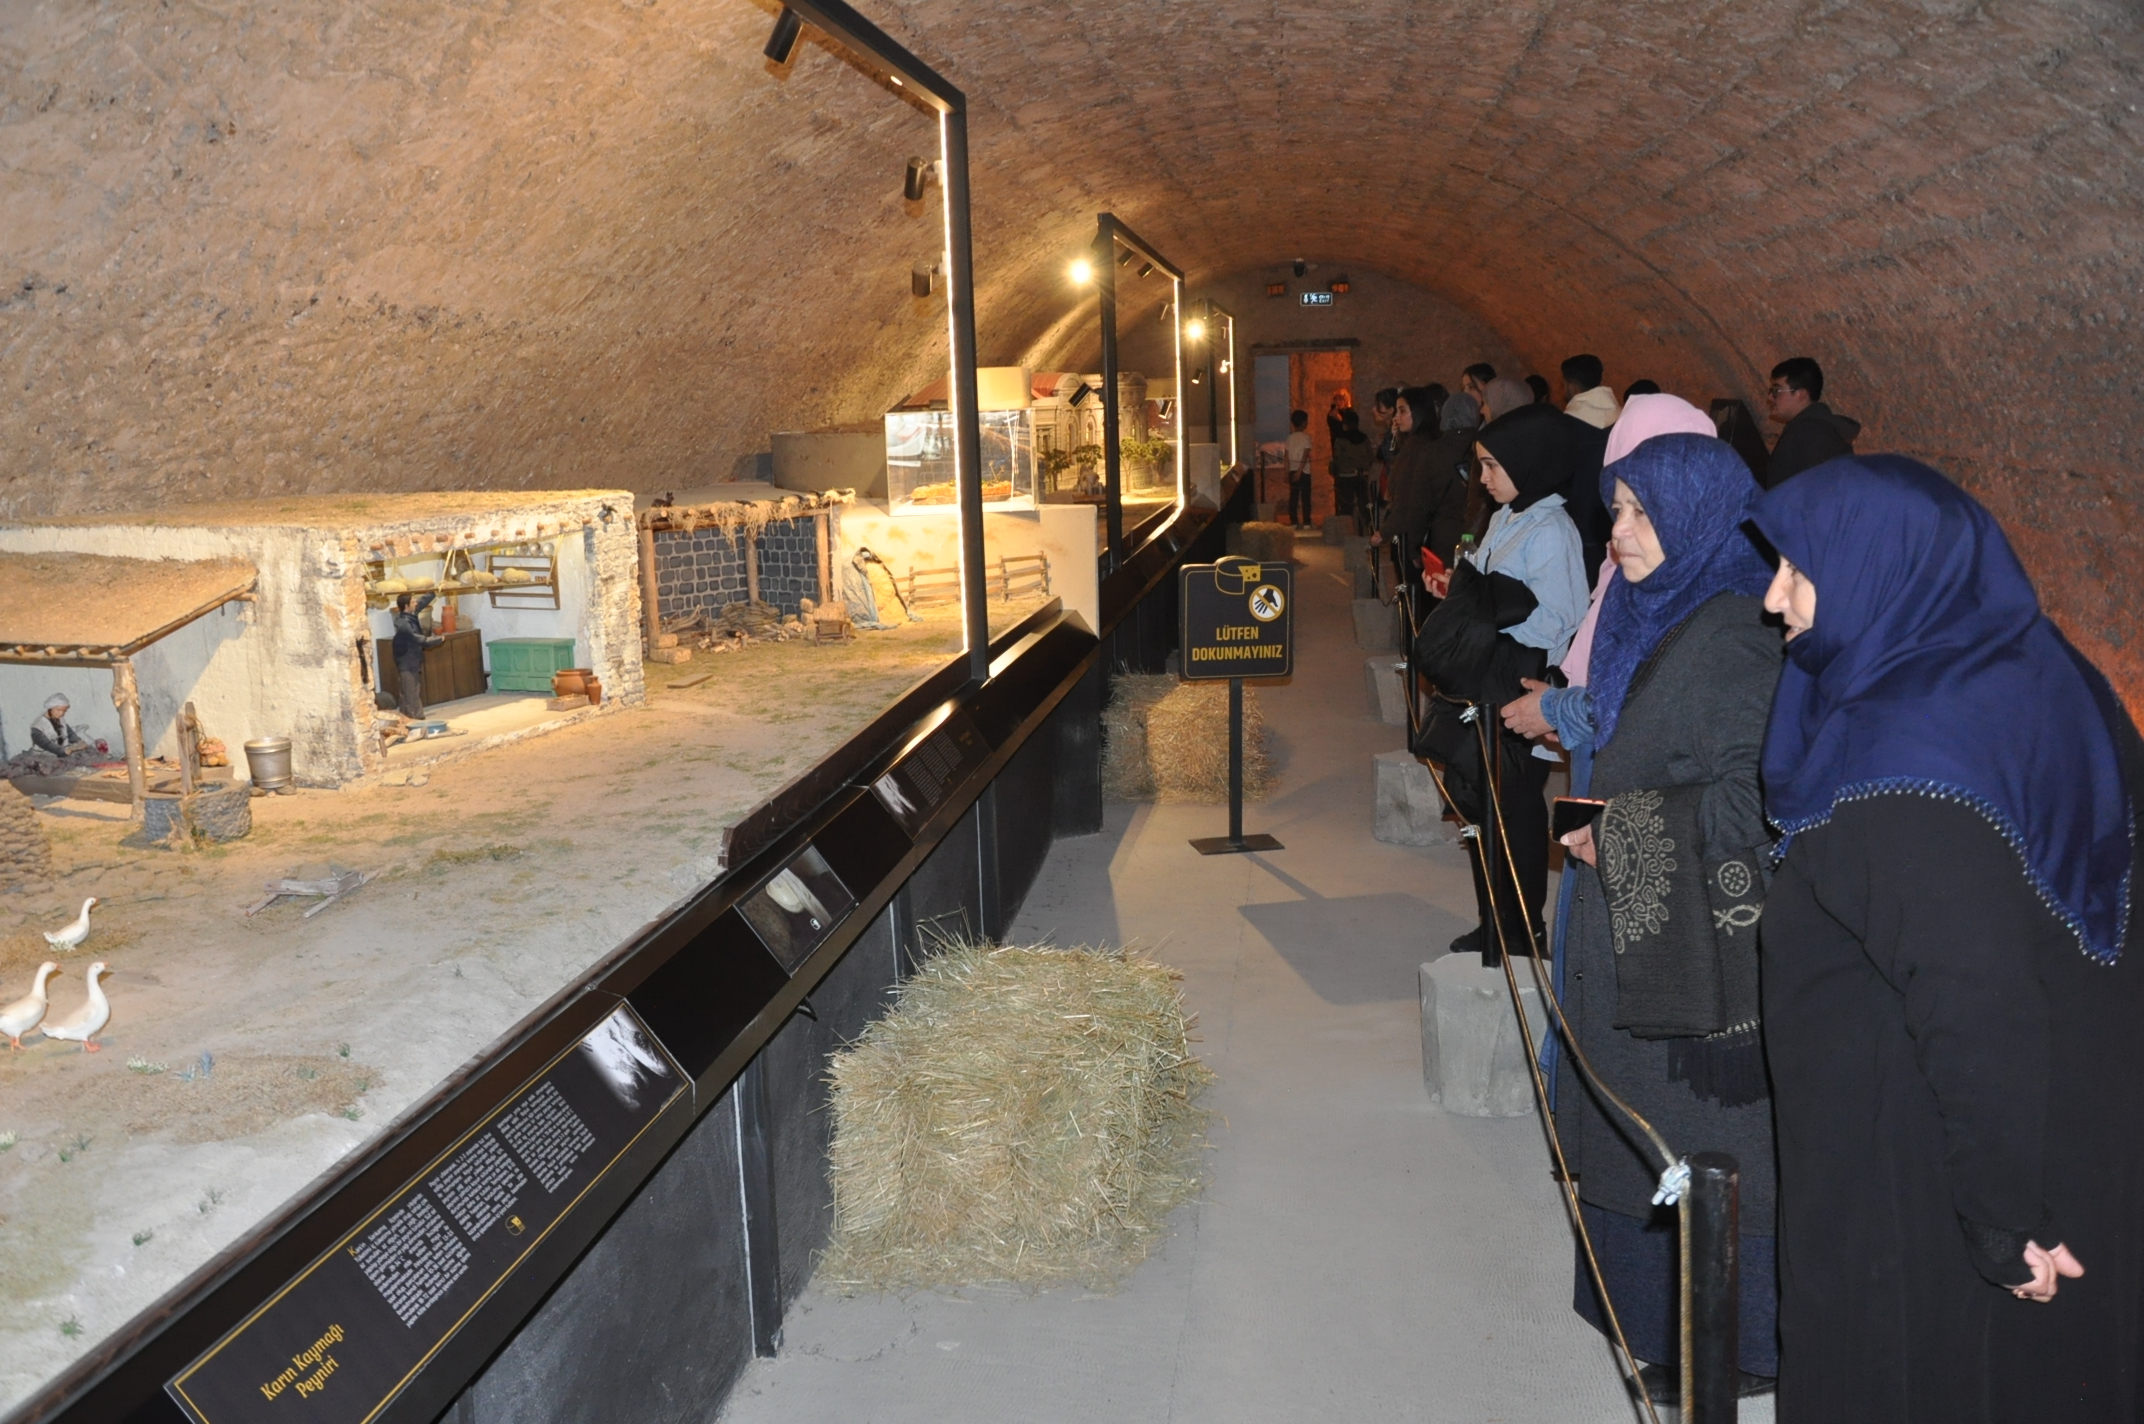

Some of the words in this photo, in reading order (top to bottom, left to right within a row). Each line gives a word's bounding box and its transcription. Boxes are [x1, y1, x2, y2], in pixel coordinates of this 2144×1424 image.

[1216, 625, 1258, 641] LÜTFEN
[1192, 645, 1282, 661] DOKUNMAYINIZ
[260, 1369, 299, 1402] Karın
[292, 1323, 345, 1371] Kaymağı
[295, 1357, 339, 1399] Peyniri
